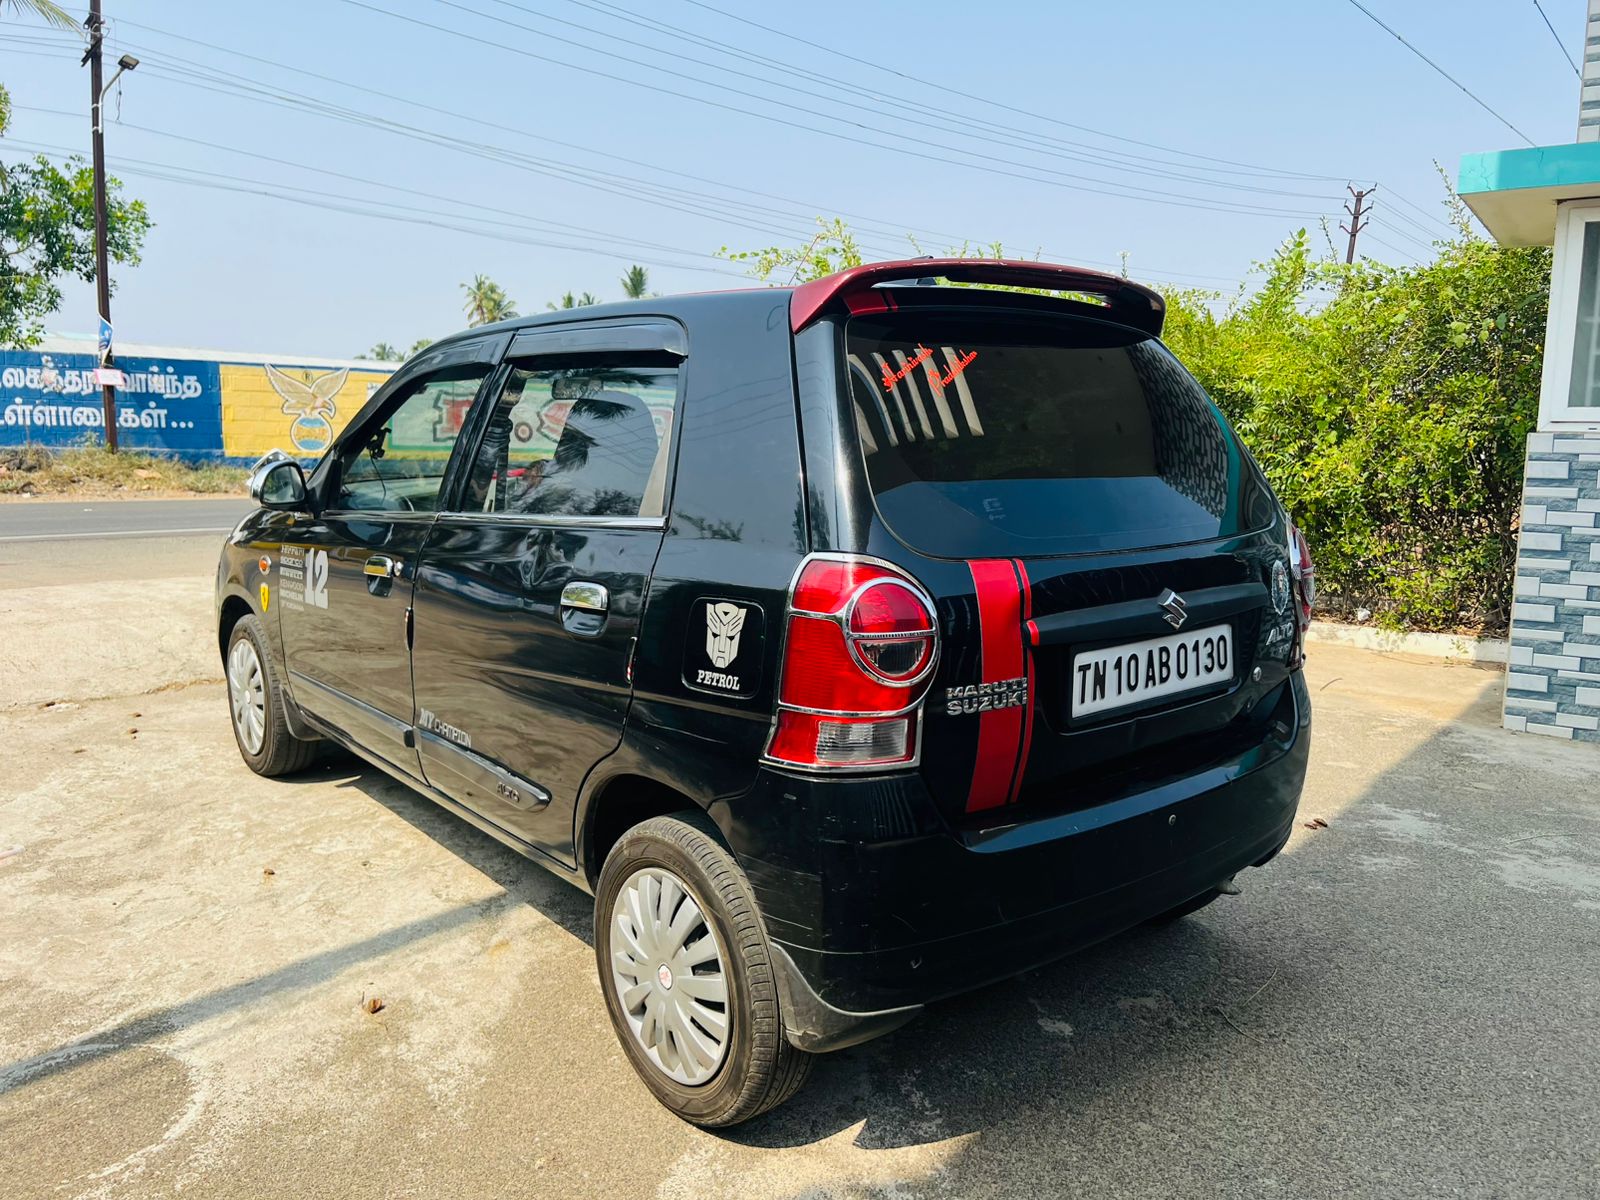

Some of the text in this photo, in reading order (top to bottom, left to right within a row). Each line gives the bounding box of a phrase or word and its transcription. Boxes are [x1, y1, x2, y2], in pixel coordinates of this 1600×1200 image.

[305, 547, 328, 609] 12
[1265, 622, 1293, 646] ALTO
[696, 669, 740, 691] PETROL
[946, 677, 1027, 699] MARUTI
[946, 690, 1027, 716] SUZUKI
[419, 707, 435, 729] MY
